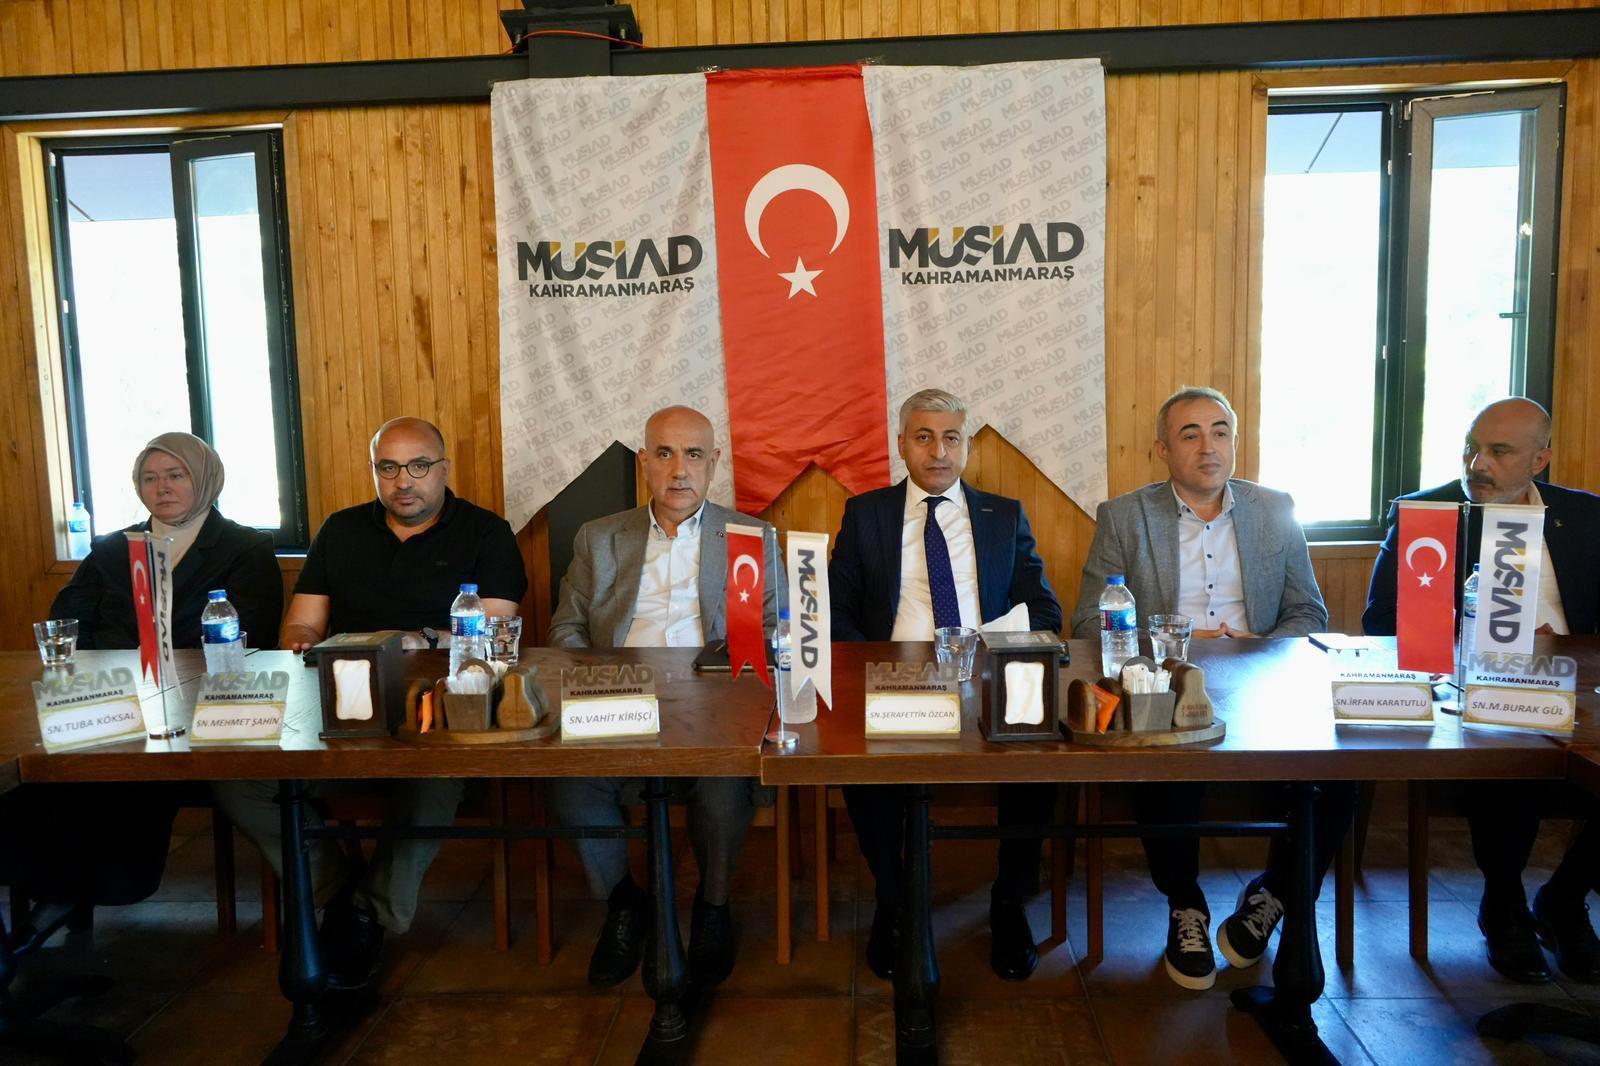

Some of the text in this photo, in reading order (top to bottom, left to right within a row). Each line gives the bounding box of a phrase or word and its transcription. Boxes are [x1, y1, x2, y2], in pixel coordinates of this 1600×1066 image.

[901, 265, 1075, 286] KAHRAMANMARAŞ
[529, 276, 695, 298] KAHRAMANMARAŞ
[1476, 675, 1561, 687] KAHRAMANMARAŞ
[570, 687, 643, 696] KAHRAMANMARAŞ
[46, 689, 124, 707] KAHRAMANMARAŞ
[1376, 699, 1427, 707] KARATUTLU
[196, 718, 251, 728] SN.MEHMET
[569, 712, 616, 725] SN.VAHİT
